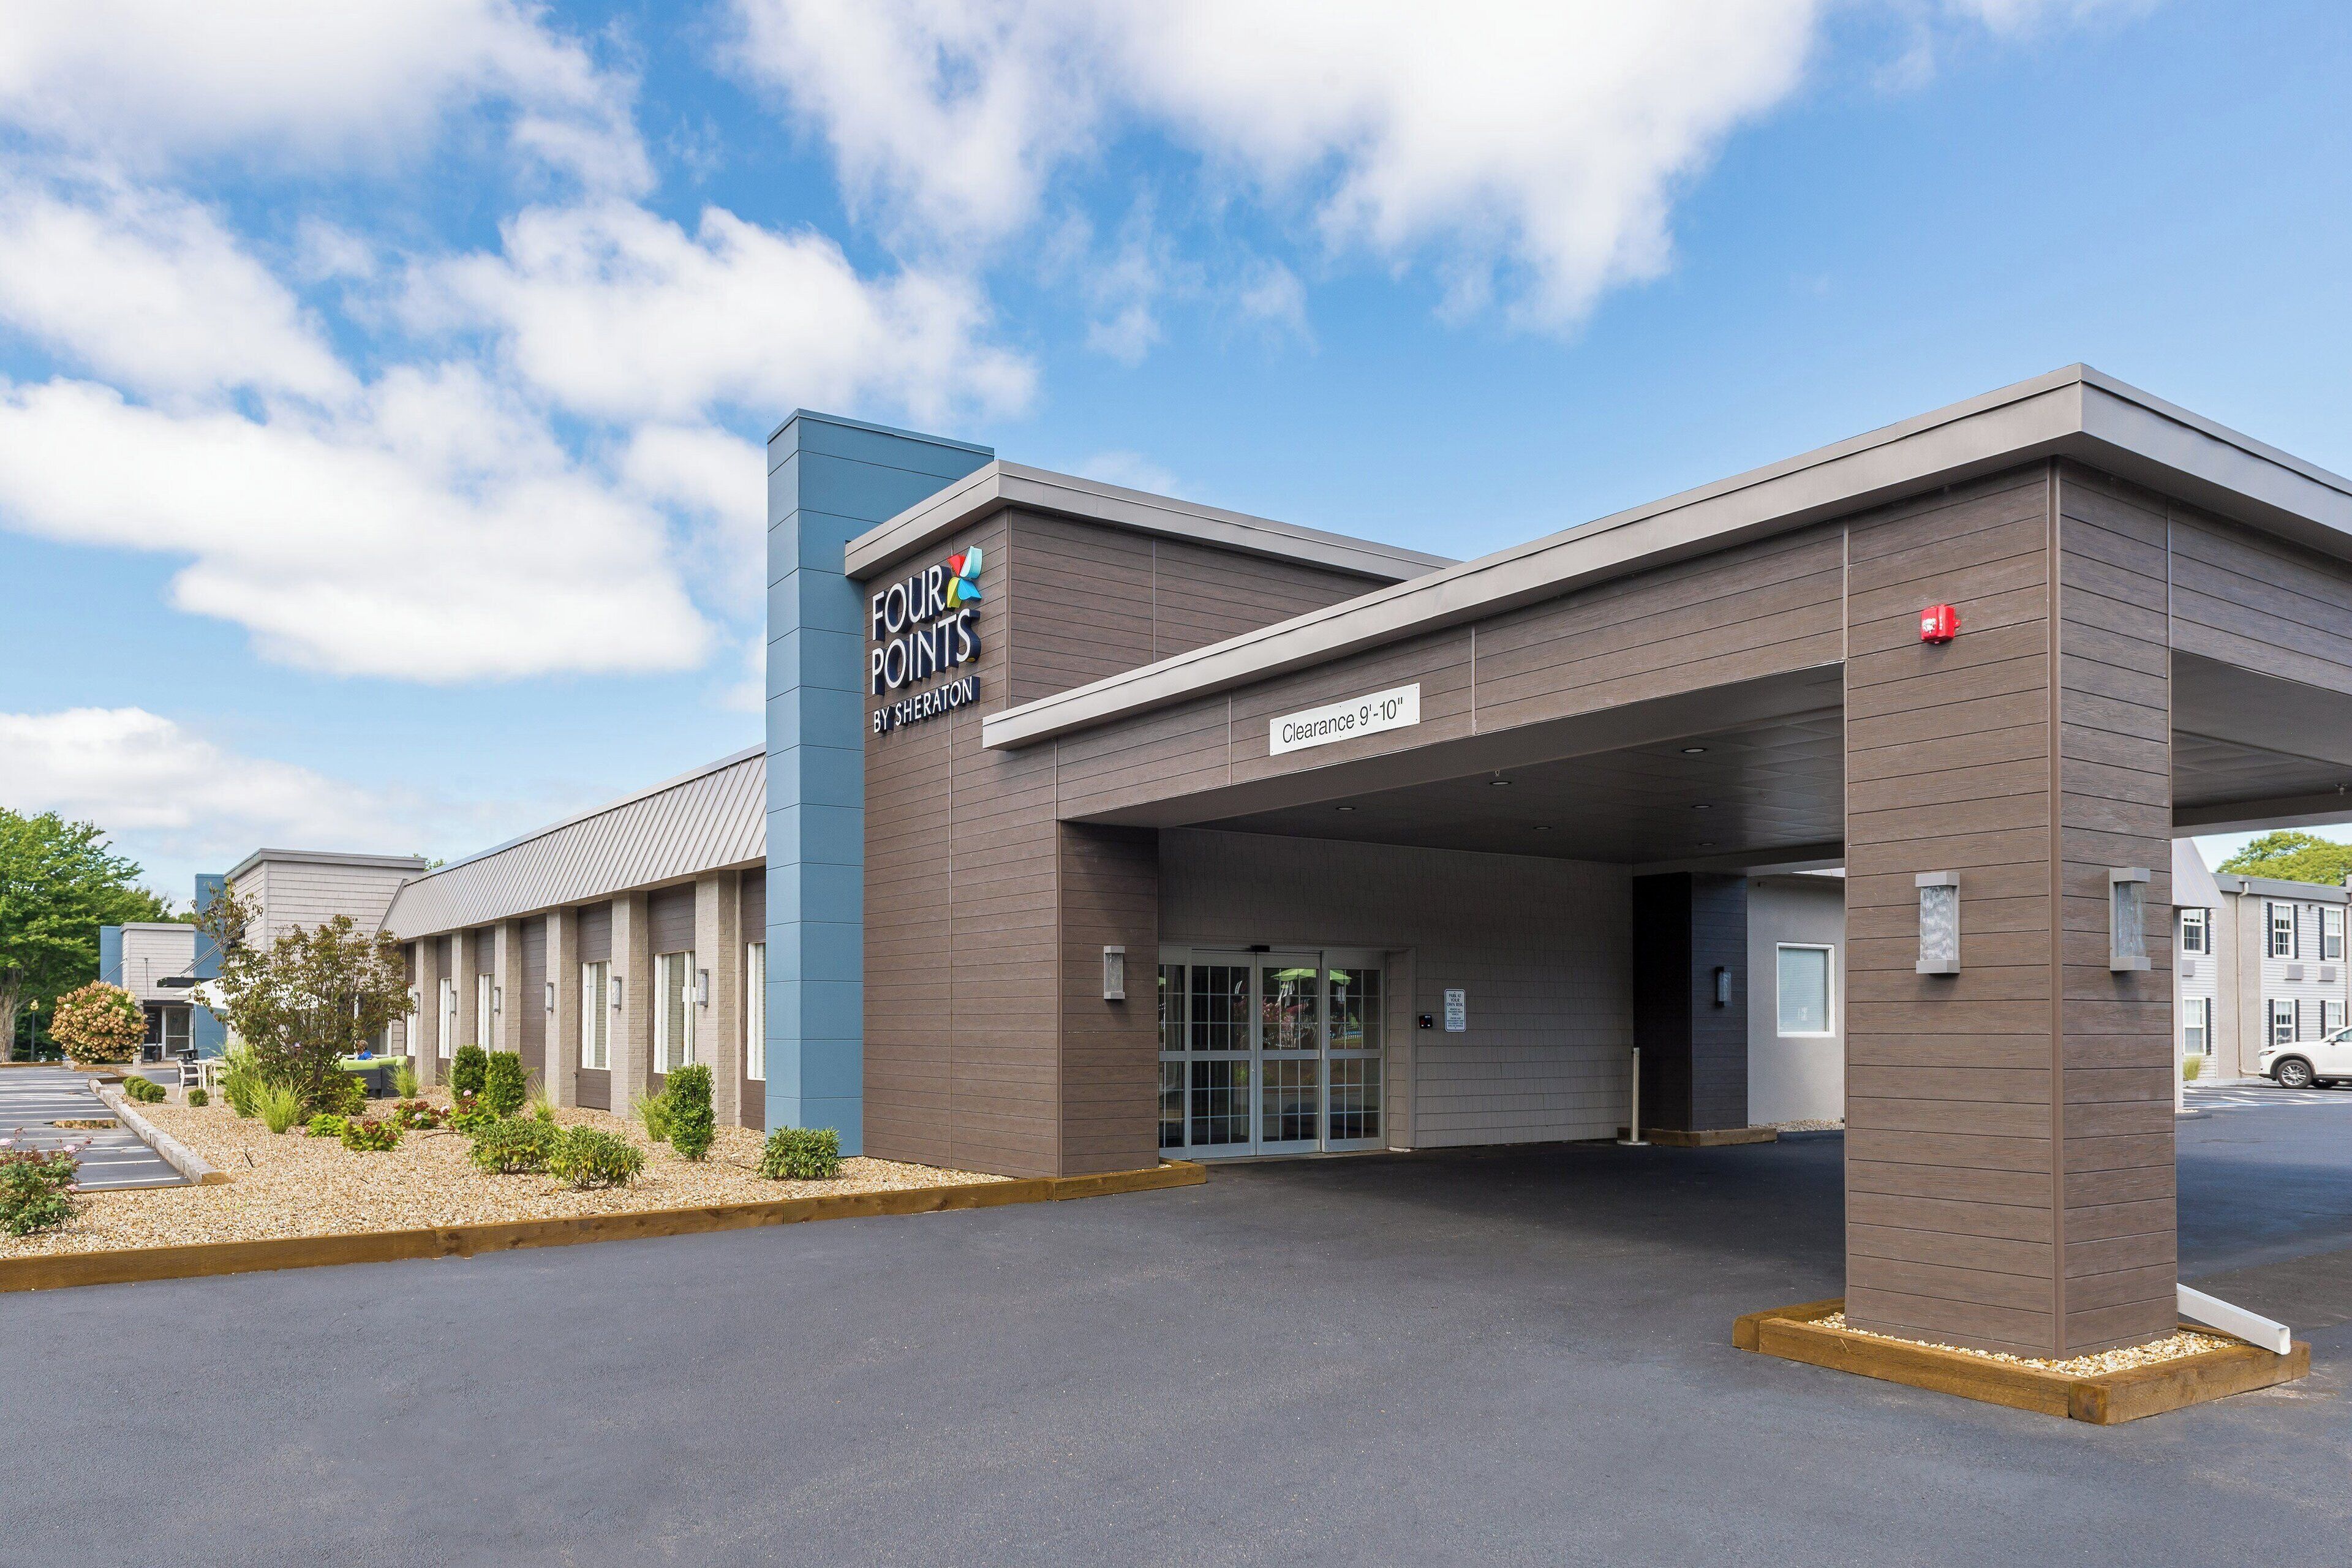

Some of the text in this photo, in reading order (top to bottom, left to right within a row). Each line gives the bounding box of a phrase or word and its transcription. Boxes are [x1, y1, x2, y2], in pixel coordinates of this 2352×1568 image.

[872, 564, 946, 641] FOUR
[872, 608, 973, 695] POINTS
[874, 676, 973, 734] BY SHERATON
[1283, 697, 1403, 743] Clearance 9'-10"
